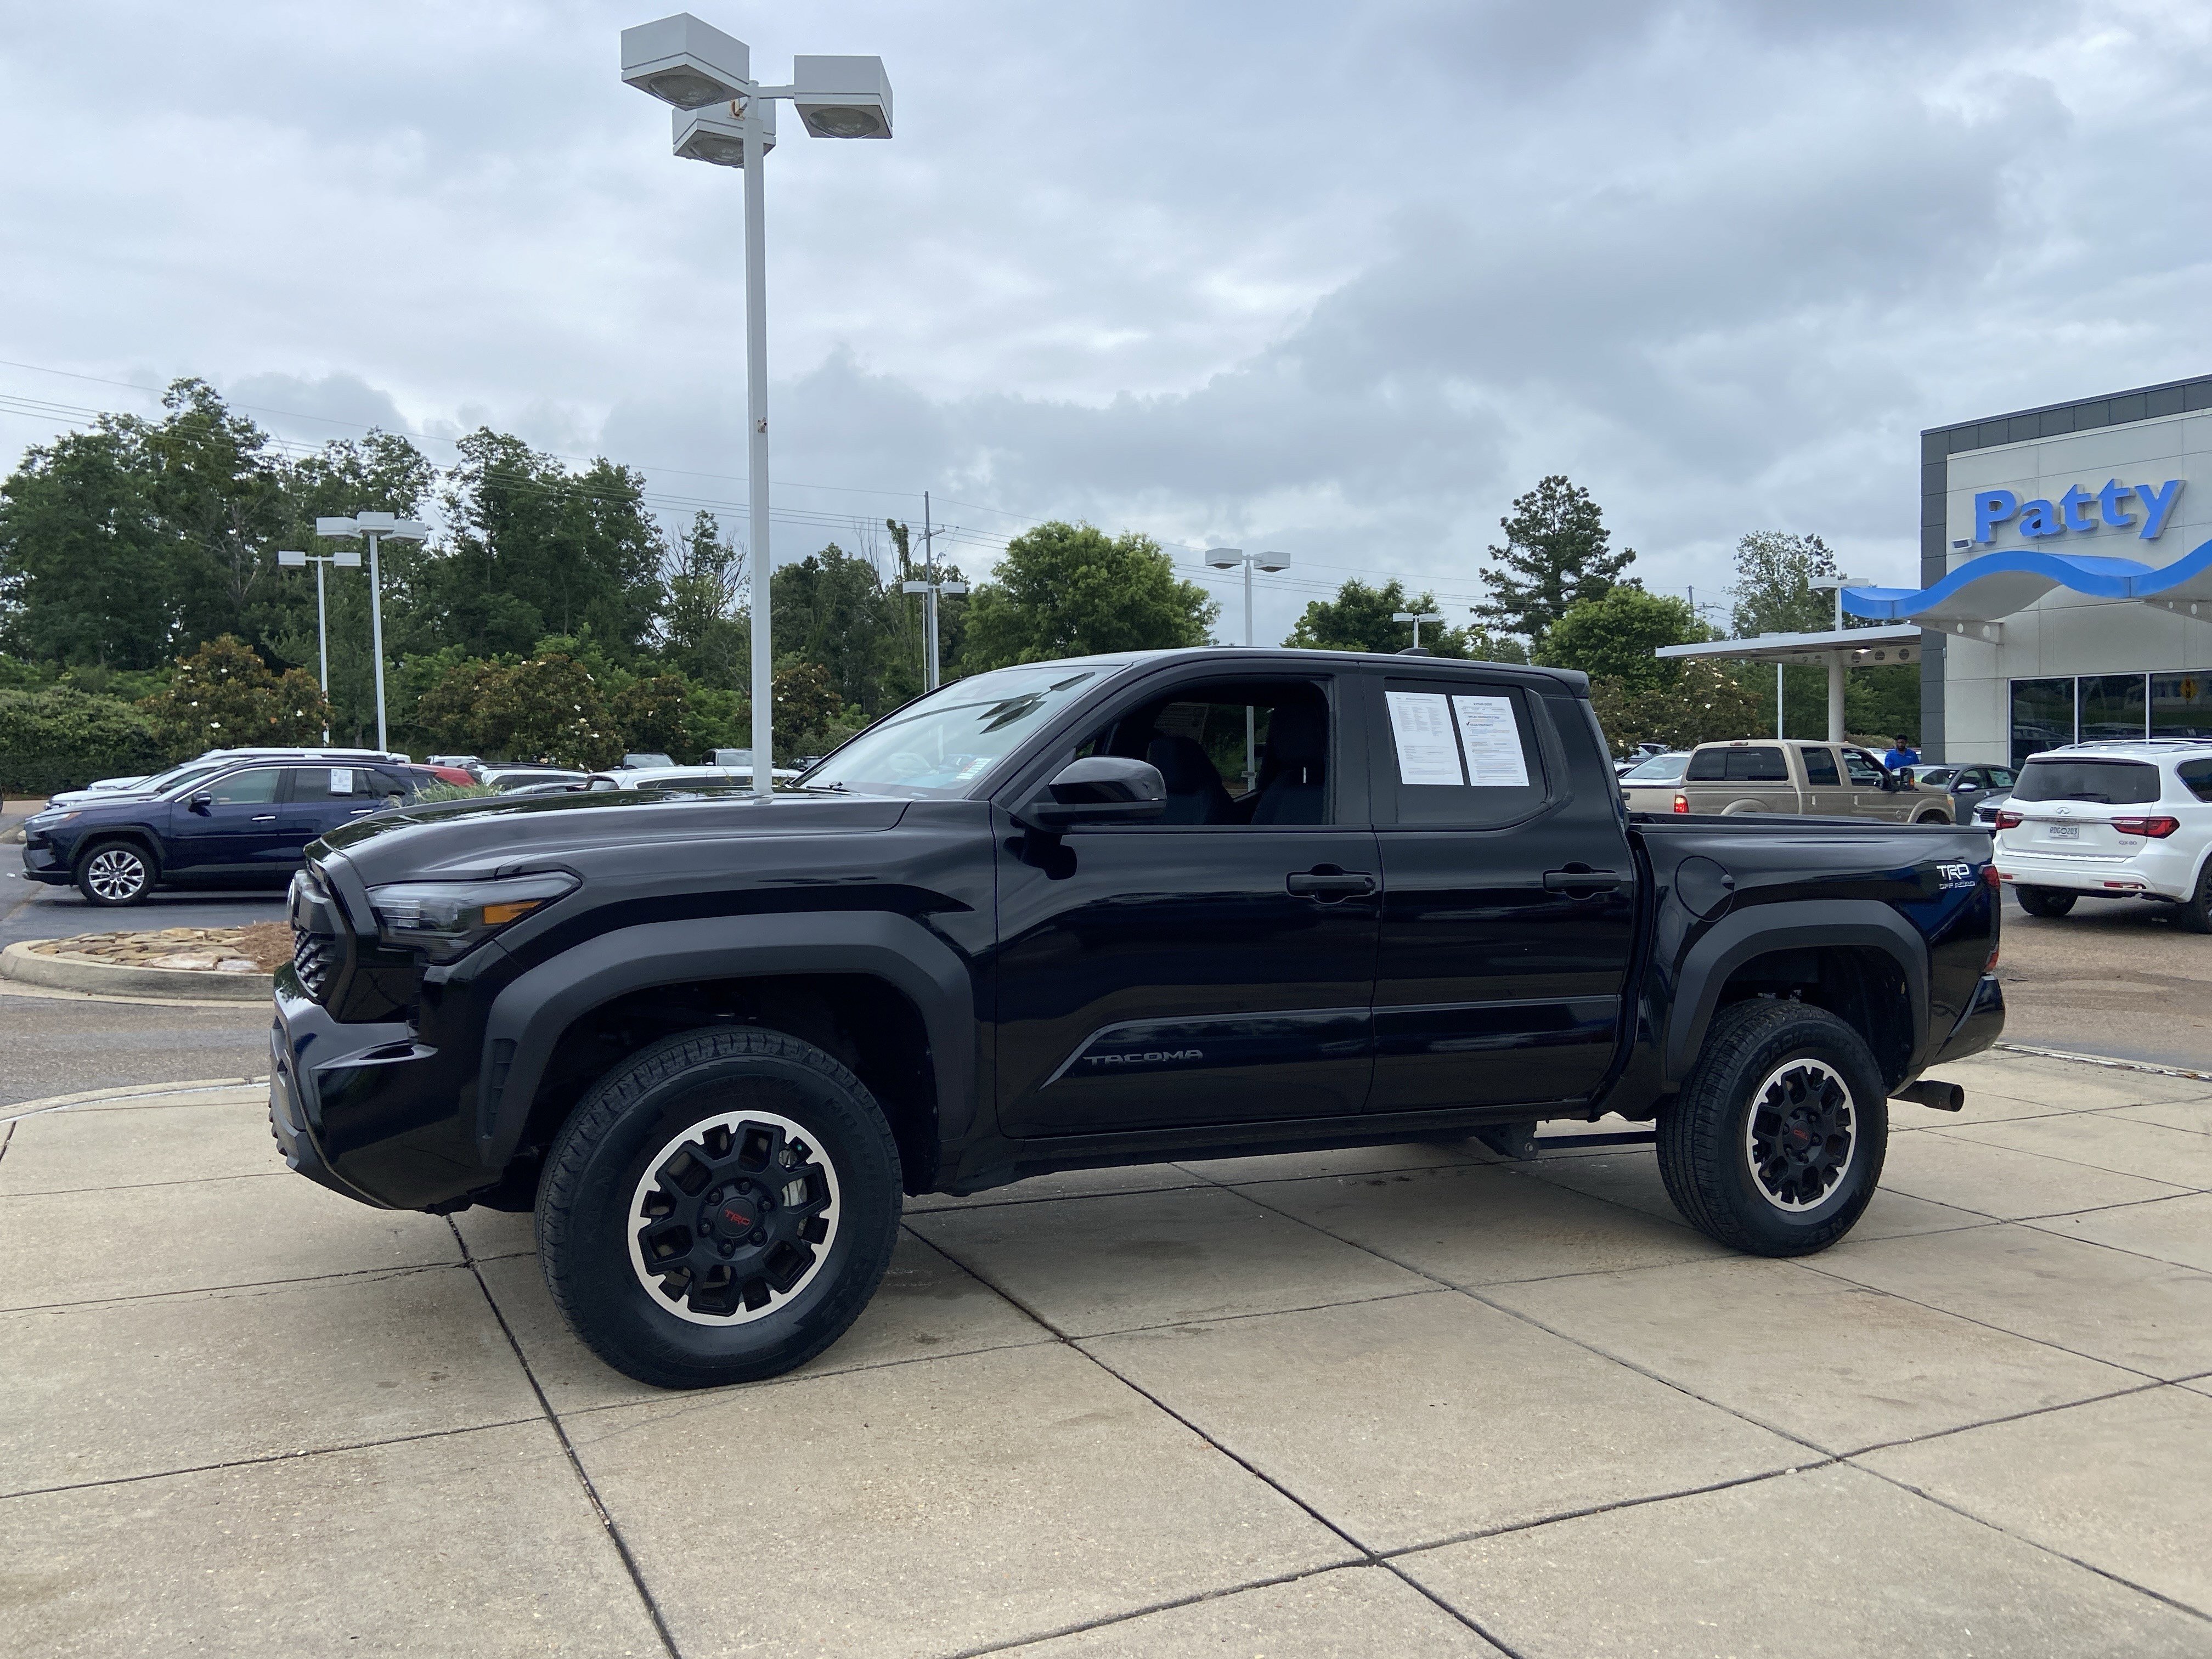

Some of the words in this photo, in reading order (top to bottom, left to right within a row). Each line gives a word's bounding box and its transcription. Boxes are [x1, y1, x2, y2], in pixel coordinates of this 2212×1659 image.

[1975, 478, 2187, 543] Patty
[1936, 864, 1971, 880] TRD
[1083, 1049, 1203, 1065] TACOMA
[725, 1207, 751, 1226] TRD
